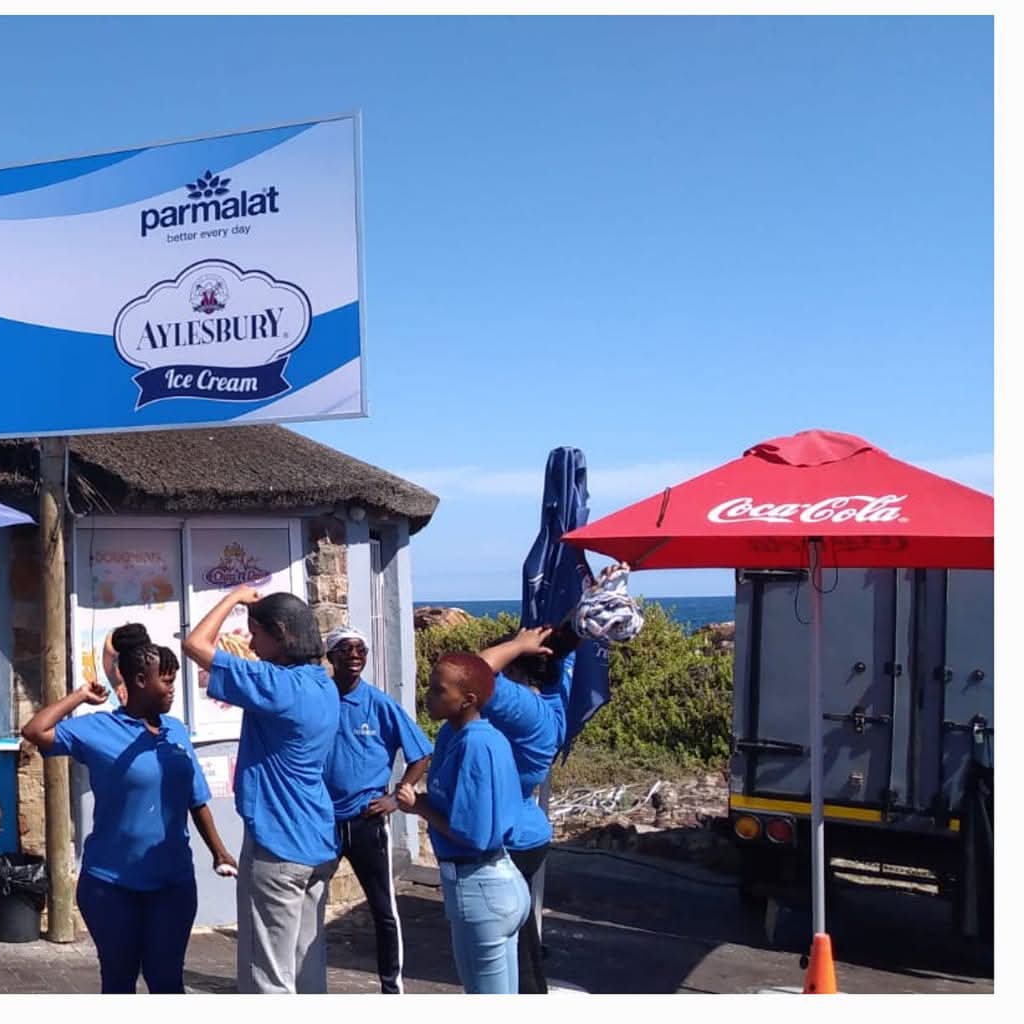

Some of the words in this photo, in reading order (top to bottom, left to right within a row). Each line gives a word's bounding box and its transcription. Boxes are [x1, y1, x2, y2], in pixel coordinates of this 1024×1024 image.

[141, 186, 280, 237] parmalat
[167, 230, 198, 243] better
[200, 228, 228, 240] every
[231, 224, 251, 236] day
[136, 307, 284, 351] AYLESBURY
[165, 368, 193, 389] Ice
[197, 368, 258, 392] Cream
[707, 494, 908, 524] Coca-Cola
